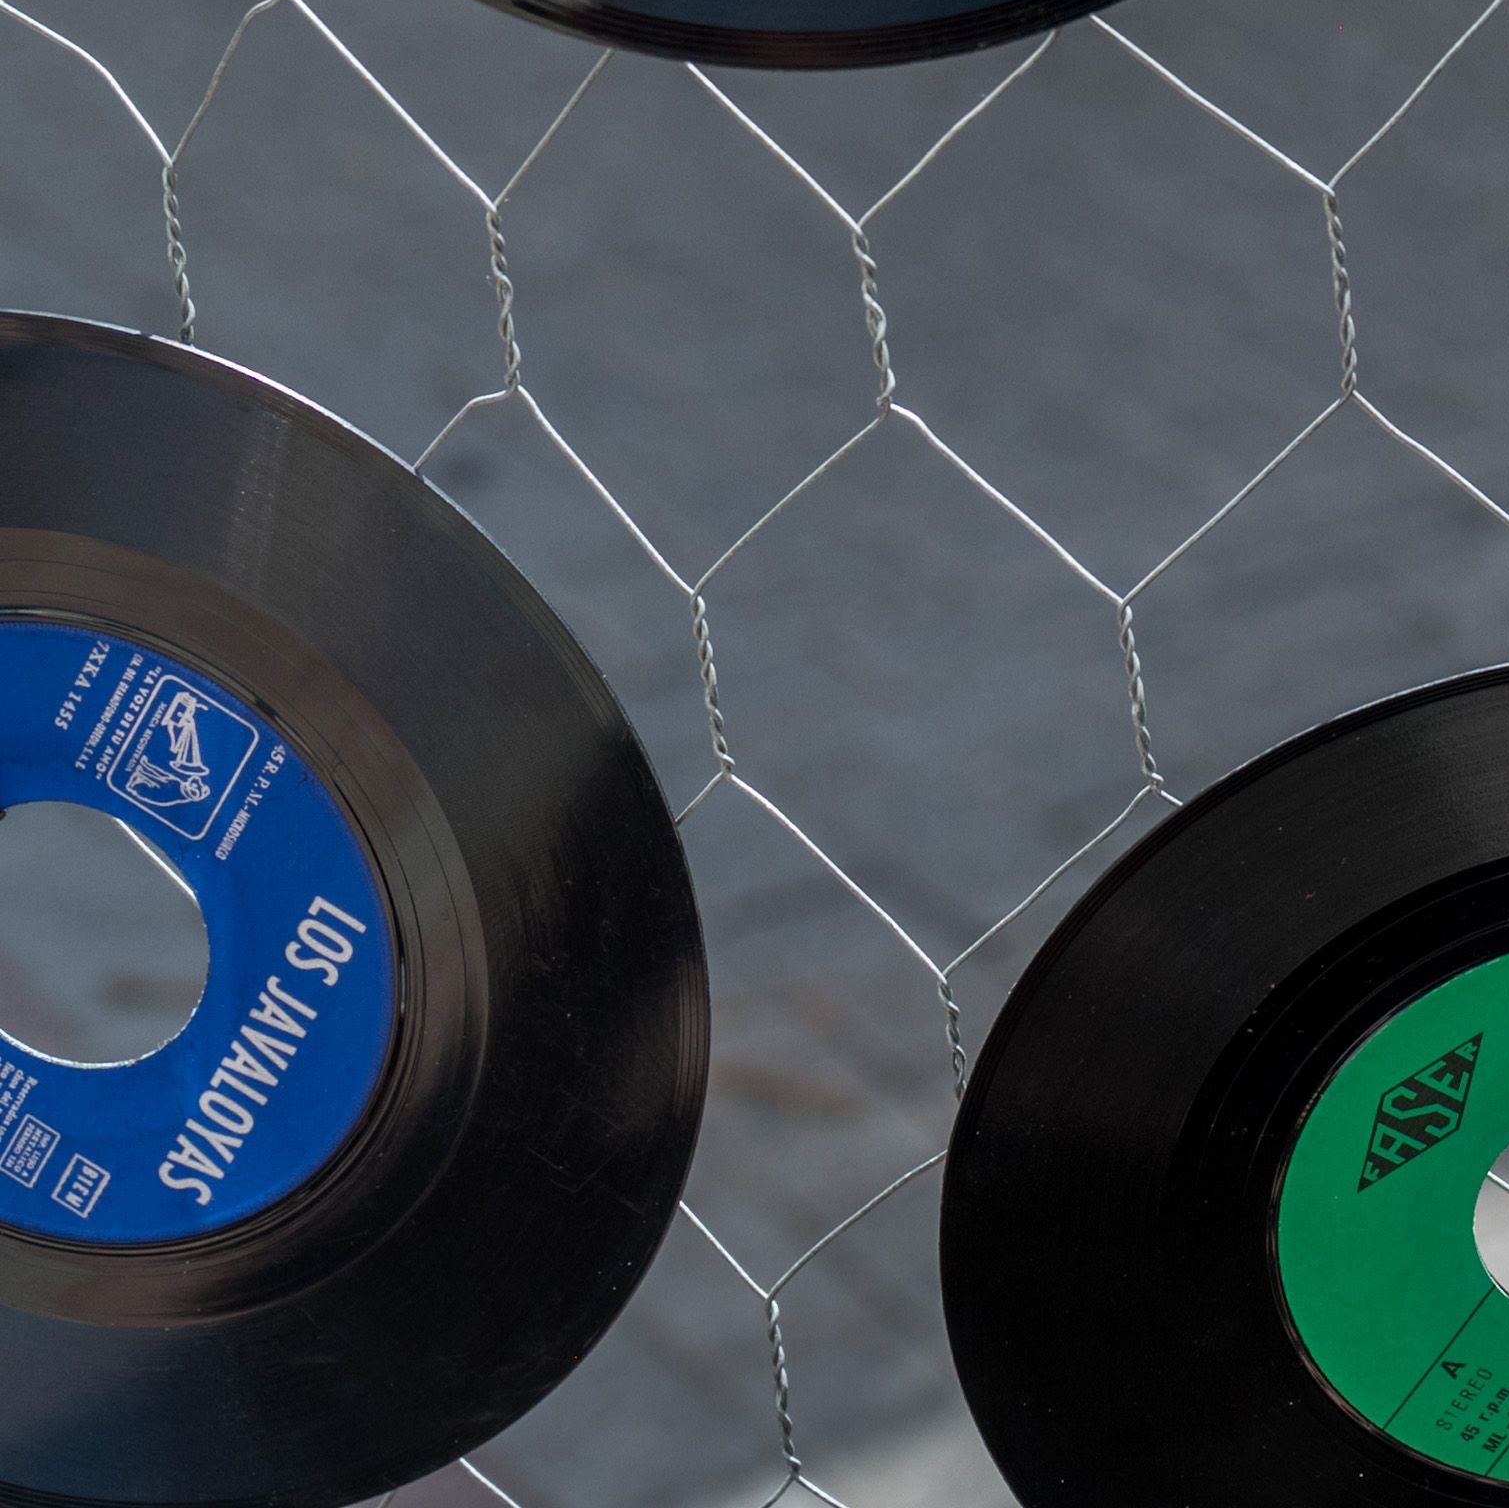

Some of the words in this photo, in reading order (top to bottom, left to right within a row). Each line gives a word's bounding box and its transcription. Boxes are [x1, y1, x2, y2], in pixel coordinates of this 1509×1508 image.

[73, 639, 112, 689] 7XKA
[127, 686, 151, 714] VOZ
[118, 710, 137, 730] DE
[110, 727, 127, 747] SU
[283, 894, 368, 988] LOS
[157, 974, 319, 1208] JAVALOYAS
[1359, 1035, 1483, 1187] FASER
[1438, 1359, 1469, 1382] A
[1434, 1365, 1495, 1432] STEREO
[1458, 1422, 1482, 1443] 45
[1480, 1431, 1509, 1454] ML
